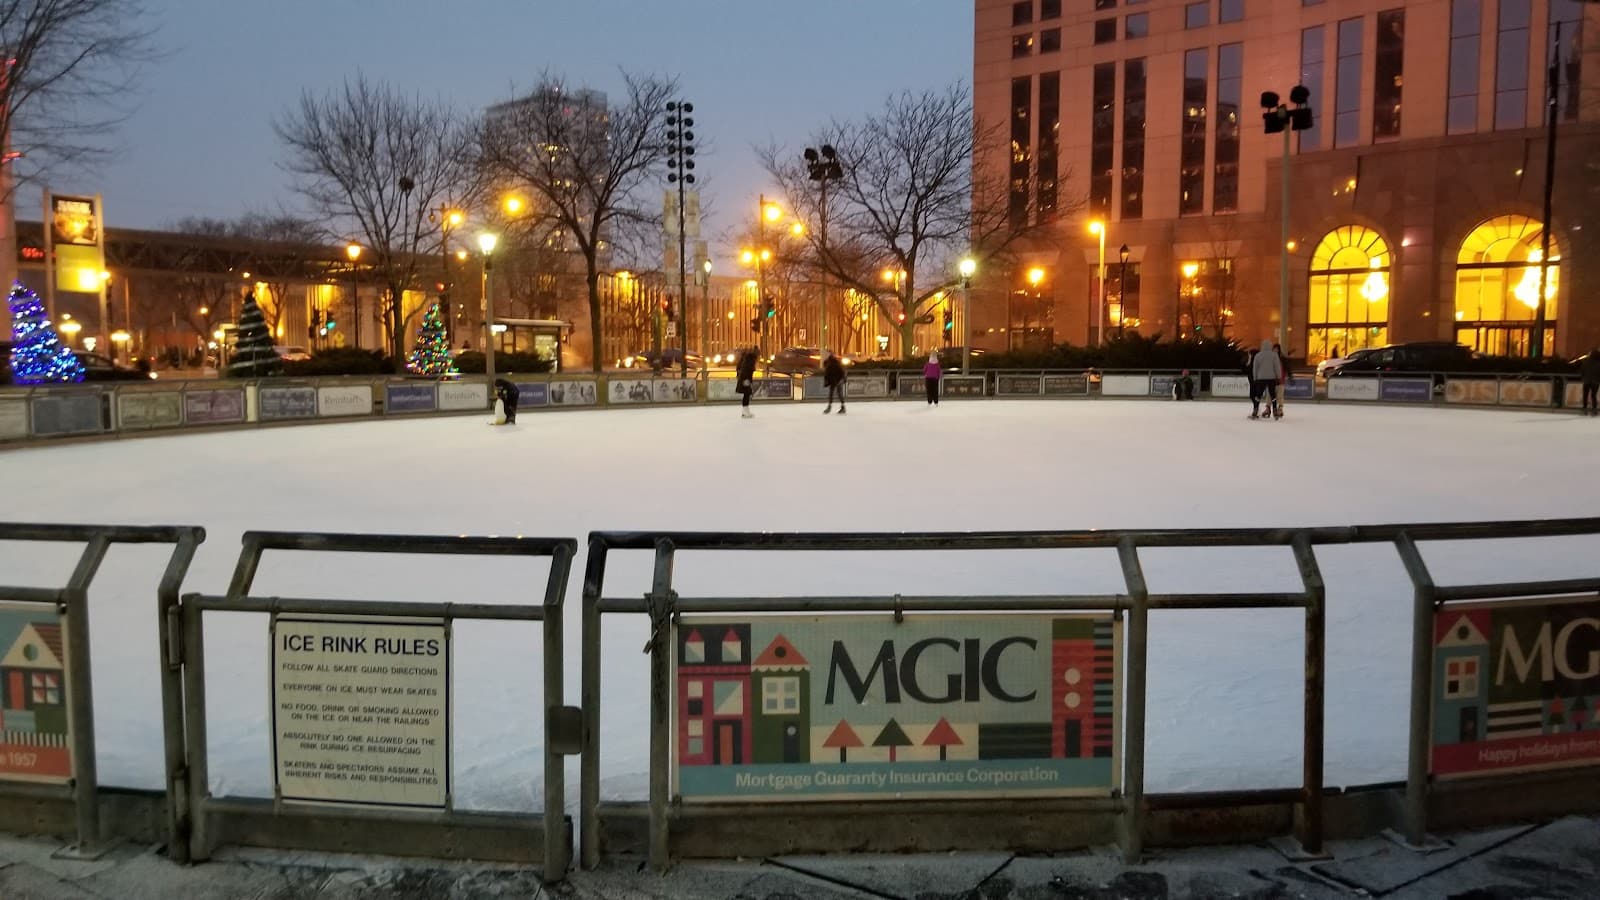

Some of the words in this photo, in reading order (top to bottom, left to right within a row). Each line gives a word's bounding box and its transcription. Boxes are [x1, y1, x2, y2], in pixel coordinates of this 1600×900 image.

[283, 635, 314, 652] ICE
[322, 636, 367, 653] RINK
[374, 638, 439, 656] RULES
[1495, 617, 1600, 686] MG
[282, 663, 314, 672] FOLLOW
[334, 665, 358, 673] SKATE
[361, 666, 388, 674] GUARD
[391, 667, 438, 676] DIRECTIONS
[824, 636, 1038, 704] MGIC
[283, 683, 322, 692] EVERYONE
[326, 684, 337, 692] ON
[356, 686, 378, 694] MUST
[381, 686, 404, 695] WEAR
[406, 688, 438, 696] SKATES
[362, 706, 399, 715] SMOKING
[402, 708, 439, 716] ALLOWED
[306, 713, 319, 721] THE
[394, 717, 430, 726] RAILINGS
[282, 732, 331, 742] ABSOLUTELY
[366, 736, 404, 745] ALLOWED
[300, 742, 316, 750] RINK
[320, 743, 349, 752] DURING
[352, 744, 364, 752] ICE
[367, 746, 422, 756] RESURFACING
[1478, 748, 1518, 763] Happy
[9, 751, 37, 768] 1957
[283, 760, 316, 770] SKATERS
[320, 762, 334, 770] AND
[336, 762, 384, 773] SPECTATORS
[387, 766, 420, 774] ASSUME
[422, 768, 436, 776] ALL
[285, 770, 322, 778] INHERENT
[324, 772, 348, 780] RISKS
[350, 774, 366, 782] AND
[368, 774, 438, 785] RESPONSIBILITIES
[735, 773, 812, 790] Mortgage
[814, 770, 887, 788] Guaranty
[889, 769, 964, 784] Insurance
[967, 767, 1059, 785] Corporation
